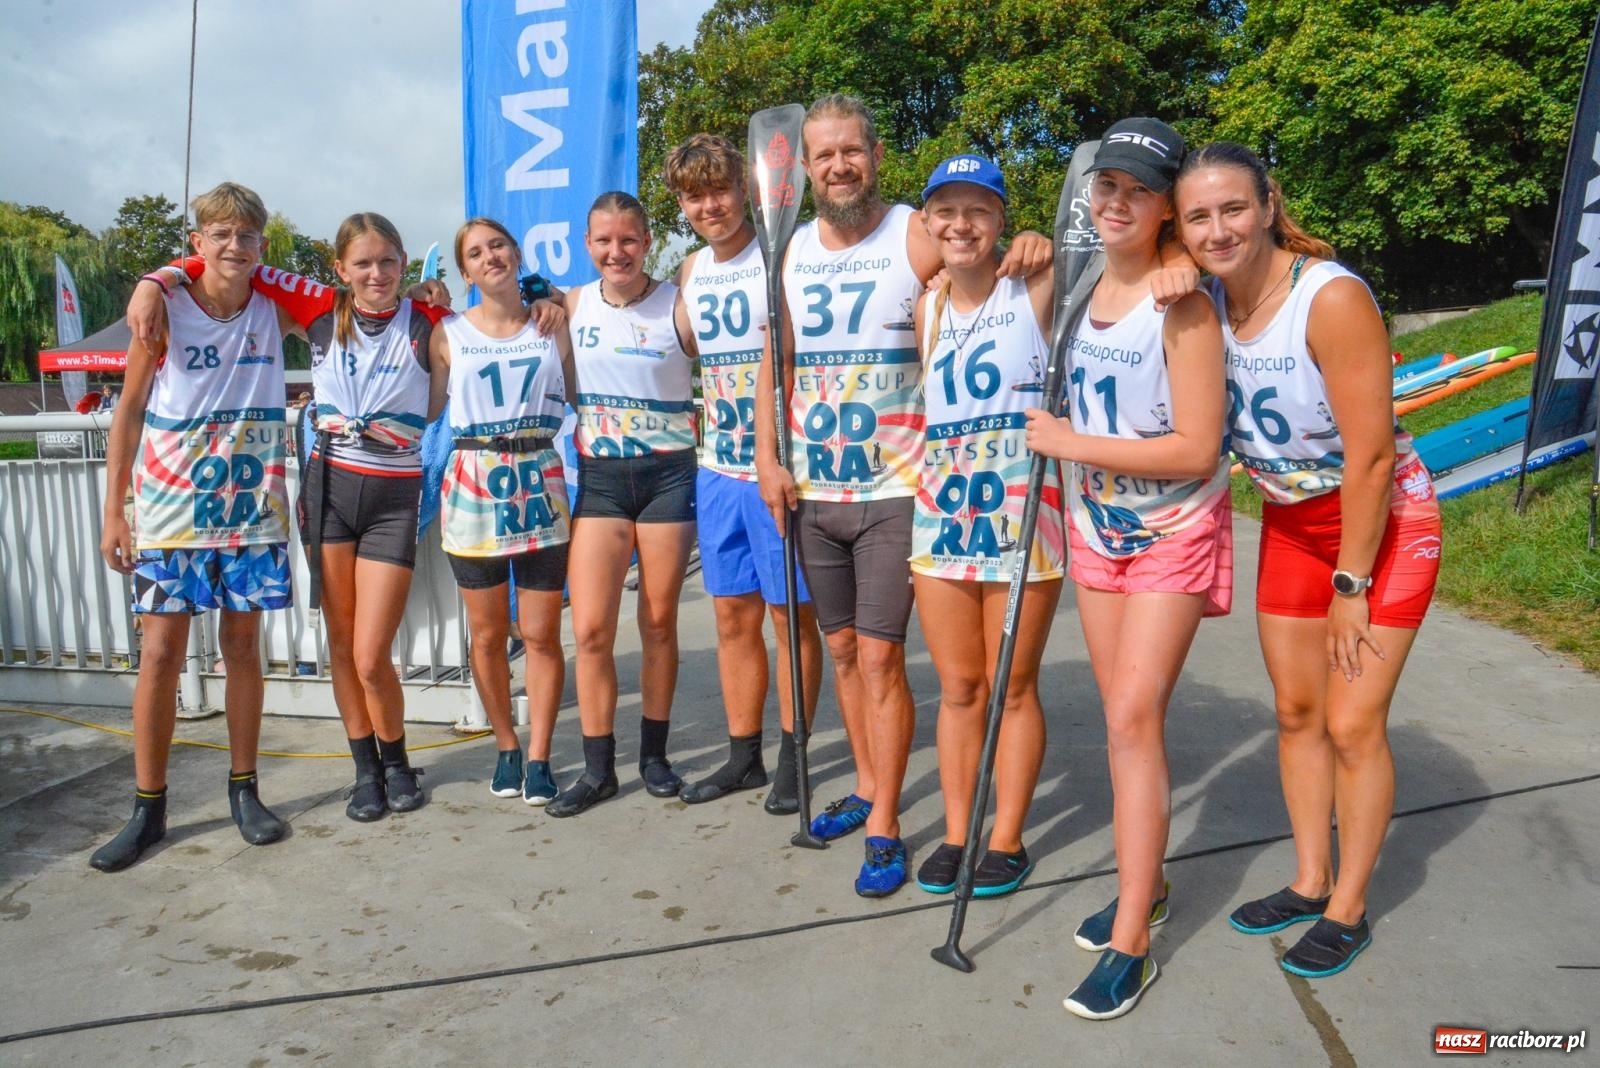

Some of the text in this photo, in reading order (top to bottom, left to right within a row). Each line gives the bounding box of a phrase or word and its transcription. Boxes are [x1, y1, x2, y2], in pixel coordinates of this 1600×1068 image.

[947, 158, 981, 175] NSP
[793, 257, 892, 275] #odrasupcup
[697, 289, 751, 341] 30
[801, 280, 877, 338] 37
[460, 340, 550, 355] #odrasupcup
[577, 325, 600, 348] 15
[184, 344, 222, 370] 28
[702, 352, 763, 366] 1-3.09.2023
[803, 352, 884, 365] 1-3.09.2023
[933, 339, 1002, 406] 16
[478, 355, 542, 408] 17
[857, 372, 905, 391] SUP
[1070, 366, 1119, 436] 11
[803, 402, 877, 443] OD
[1226, 378, 1292, 446] 26
[806, 443, 875, 483] RA
[986, 438, 1031, 460] SU
[191, 453, 265, 491] OD
[486, 459, 546, 501] OD
[193, 491, 262, 529] RA
[935, 470, 1006, 516] OD
[494, 495, 556, 537] RA
[930, 515, 1001, 558] RA
